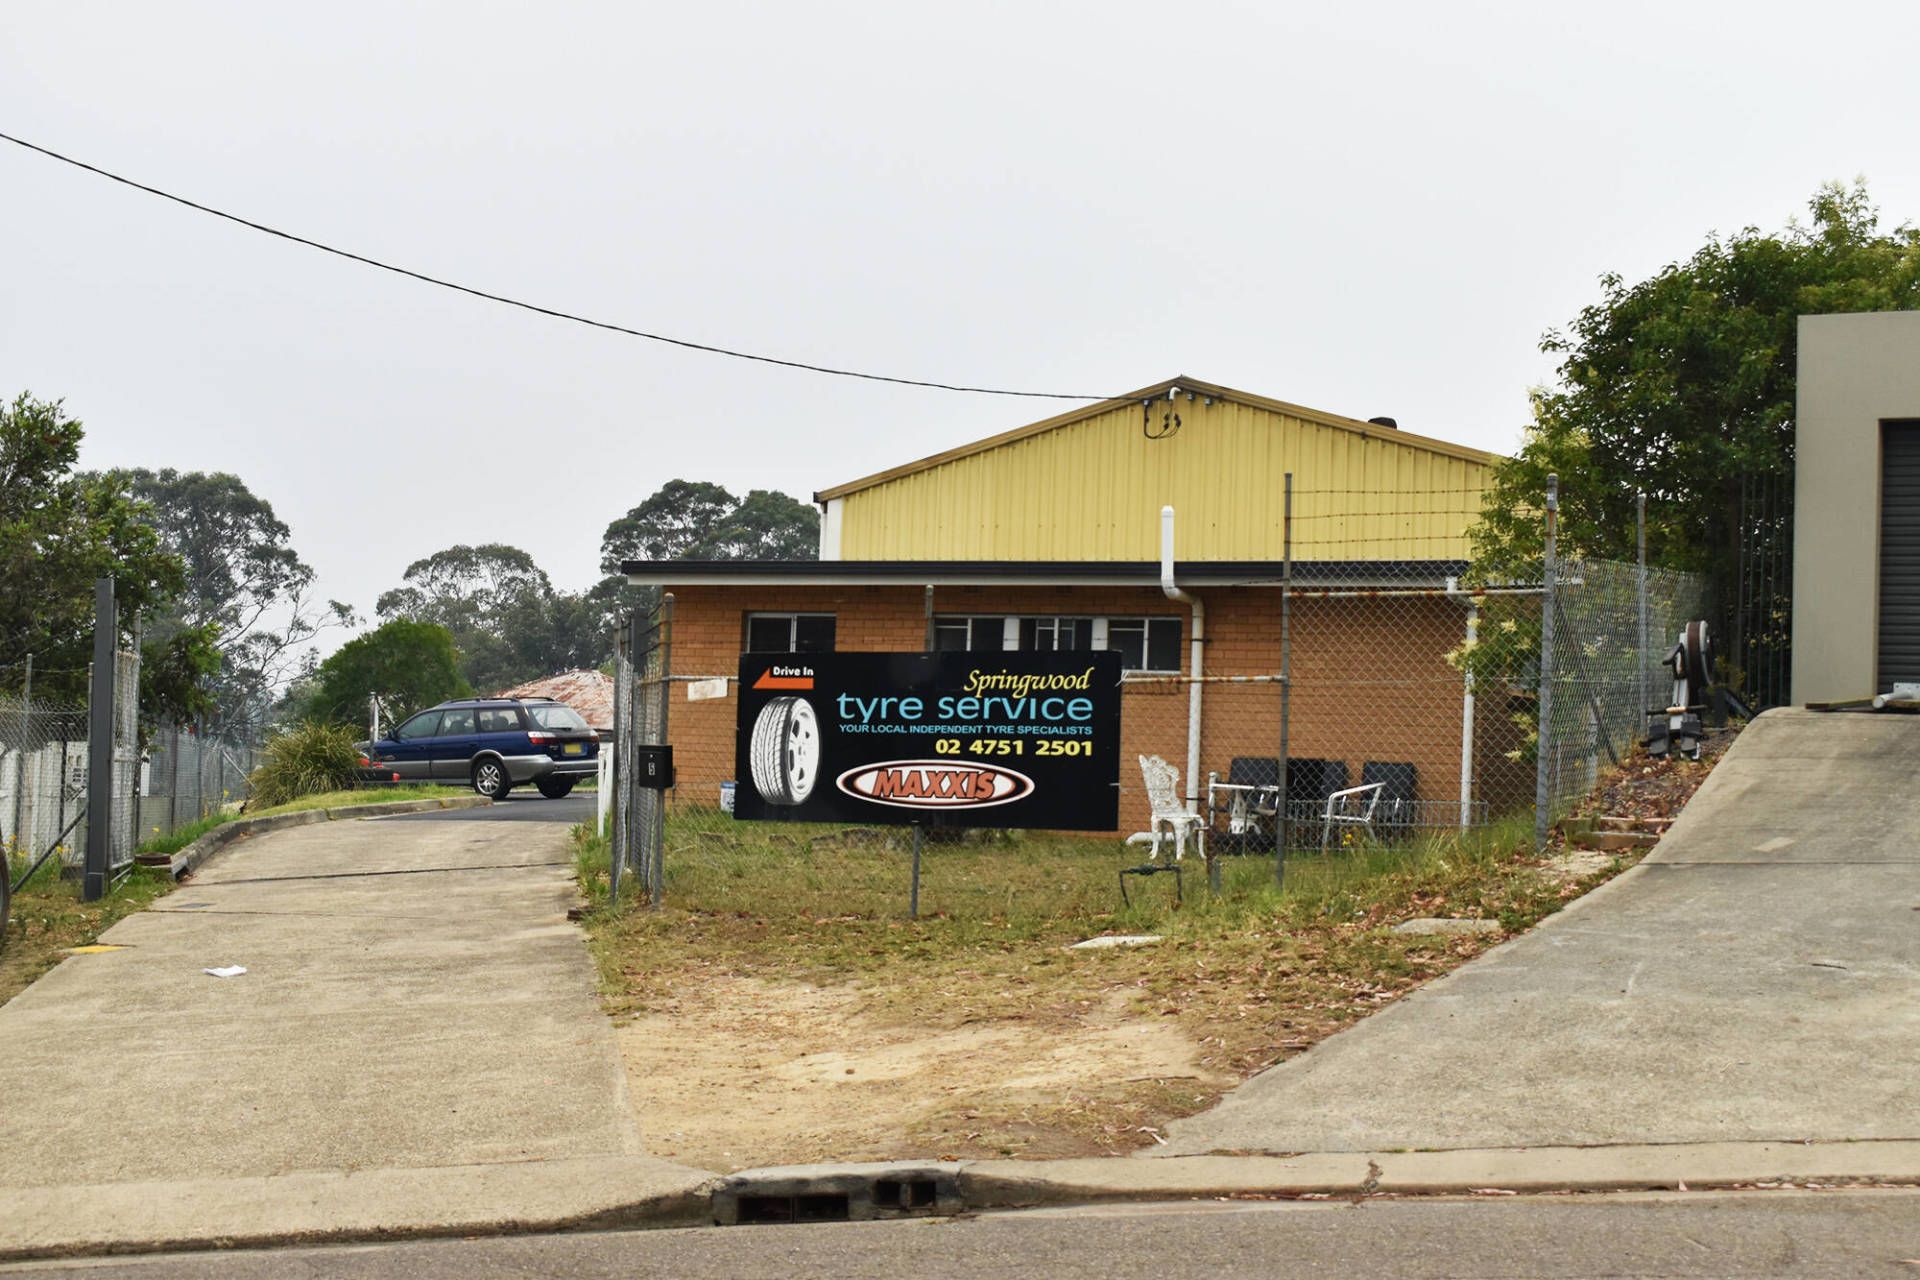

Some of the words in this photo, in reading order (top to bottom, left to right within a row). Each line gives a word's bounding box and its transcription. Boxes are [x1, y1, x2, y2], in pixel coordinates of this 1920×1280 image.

[773, 666, 800, 676] Drive
[803, 666, 814, 676] In
[963, 666, 1095, 699] Springwood
[836, 692, 924, 724] tyre
[938, 696, 1093, 720] service
[840, 724, 869, 733] YOUR
[871, 724, 907, 734] LOCAL
[909, 724, 983, 734] INDEPENDENT
[985, 725, 1015, 734] TYRE
[1017, 725, 1093, 735] SPECIALISTS
[935, 739, 961, 755] 02
[968, 739, 1023, 755] 4751
[1035, 740, 1092, 756] 2501
[872, 769, 997, 800] MAXXIS
